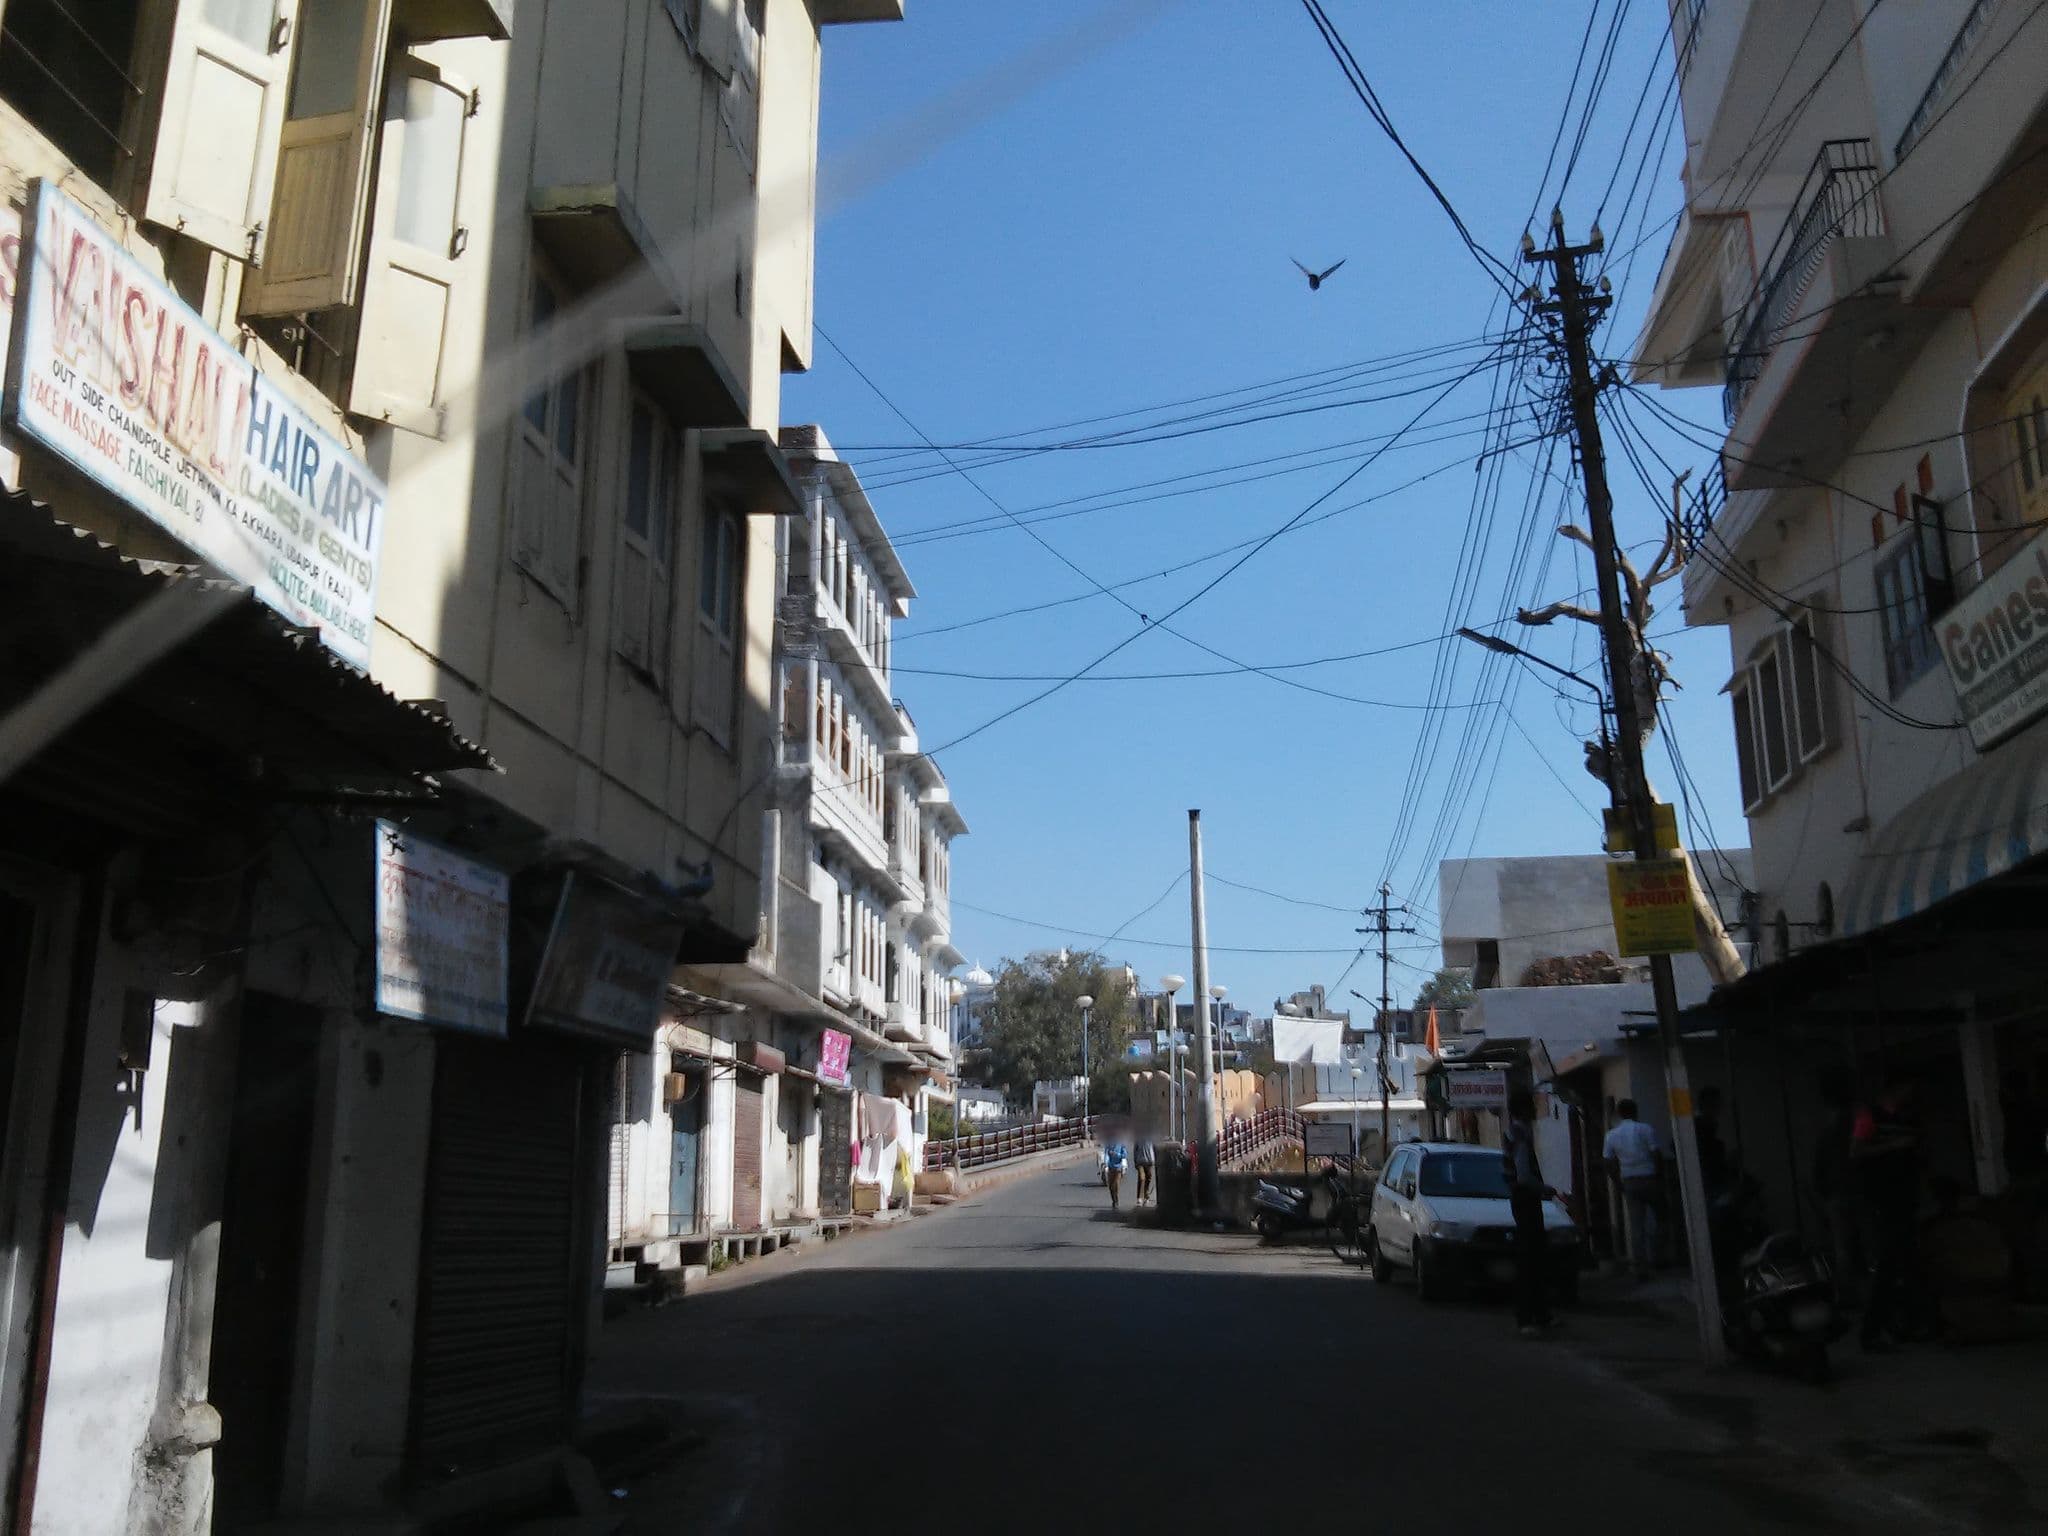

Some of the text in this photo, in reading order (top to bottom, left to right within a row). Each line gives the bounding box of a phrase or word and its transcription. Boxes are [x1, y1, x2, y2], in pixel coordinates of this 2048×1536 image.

[29, 371, 58, 418] FACE
[127, 447, 191, 516] FAISHIYAL
[53, 359, 76, 389] OUT
[81, 382, 105, 413] SIDE
[108, 404, 171, 464] CHANDPOLE
[242, 511, 283, 551] AKHARA
[286, 542, 319, 580] UDAIPUR
[247, 386, 320, 508] HAIR
[321, 461, 382, 552] ART
[318, 531, 372, 593] GENTS)
